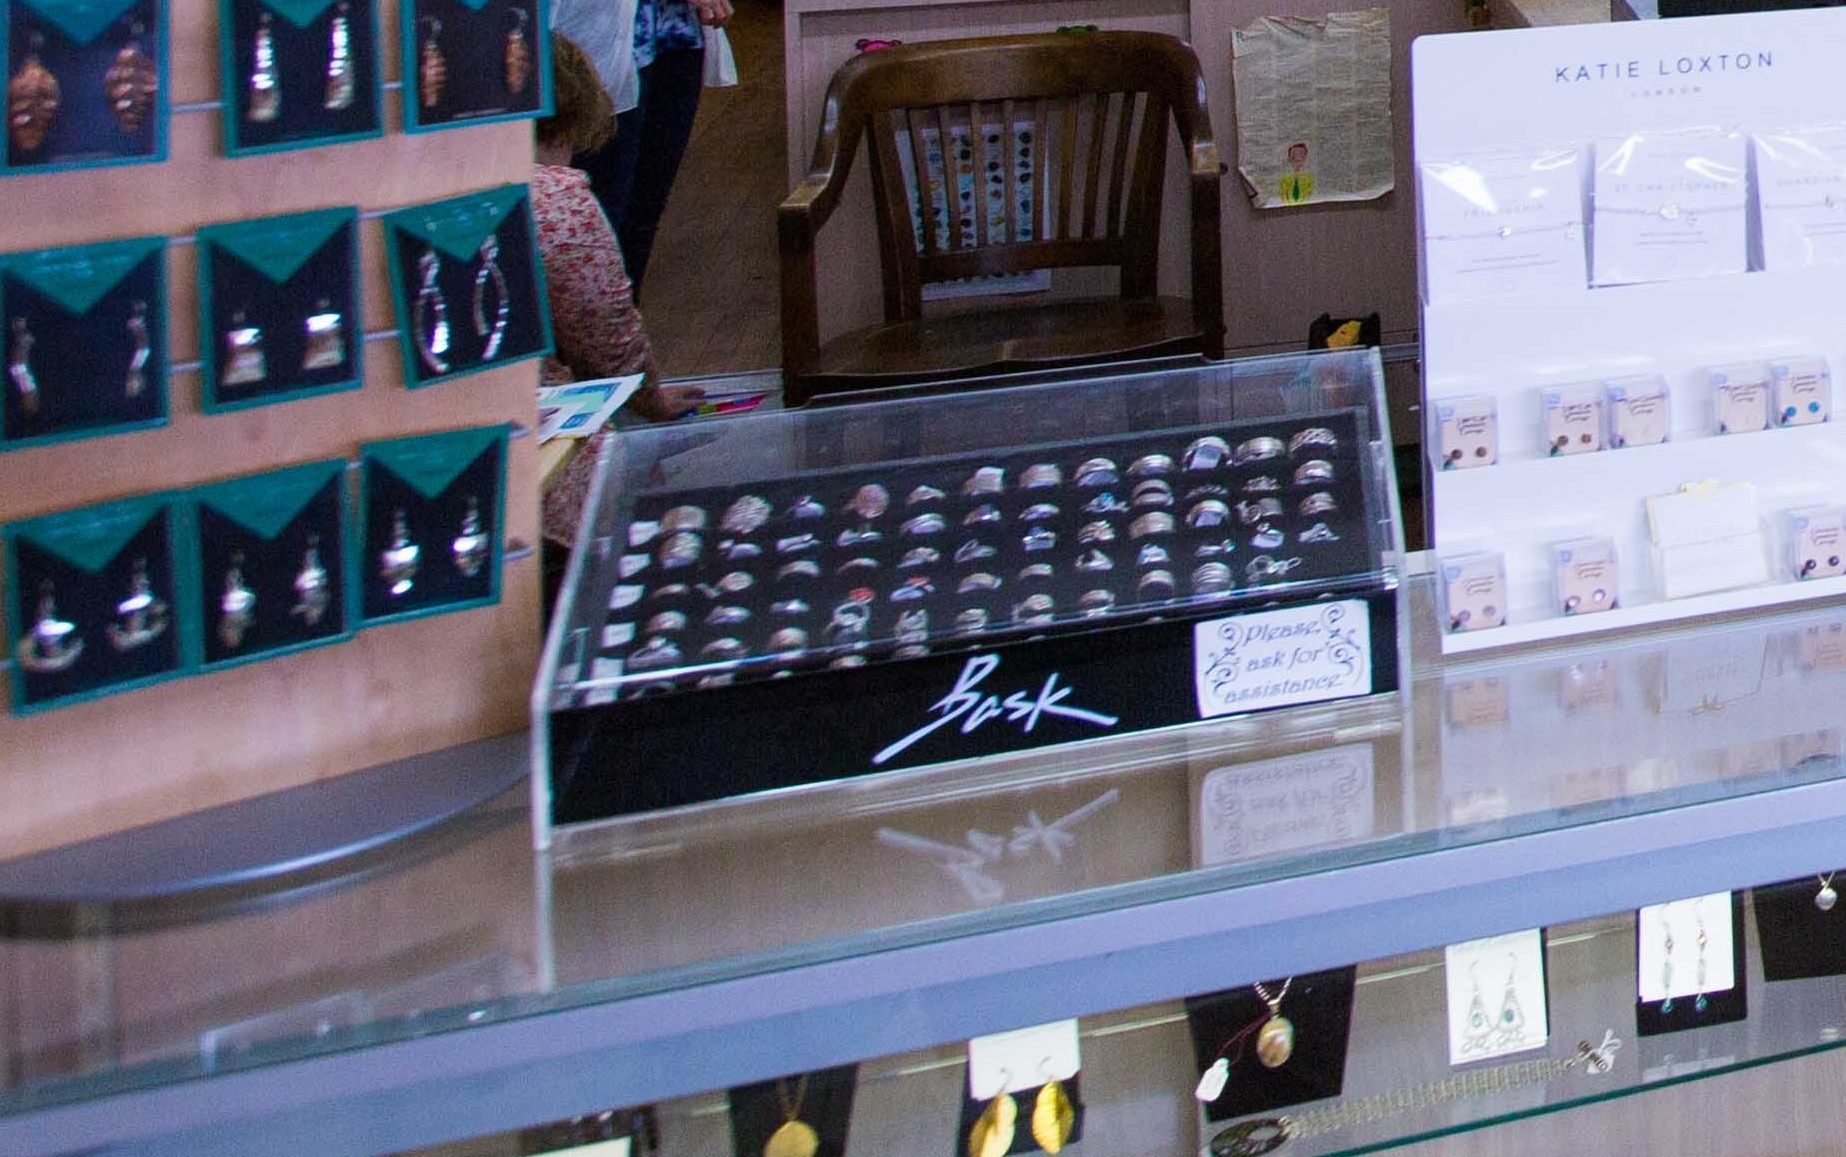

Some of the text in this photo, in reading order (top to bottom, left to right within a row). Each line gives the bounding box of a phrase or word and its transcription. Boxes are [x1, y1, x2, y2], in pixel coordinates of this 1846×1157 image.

[1554, 50, 1775, 84] KATIE LOXTON
[1246, 647, 1325, 673] ask for
[1223, 674, 1343, 704] assistance
[871, 653, 1120, 765] Bask
